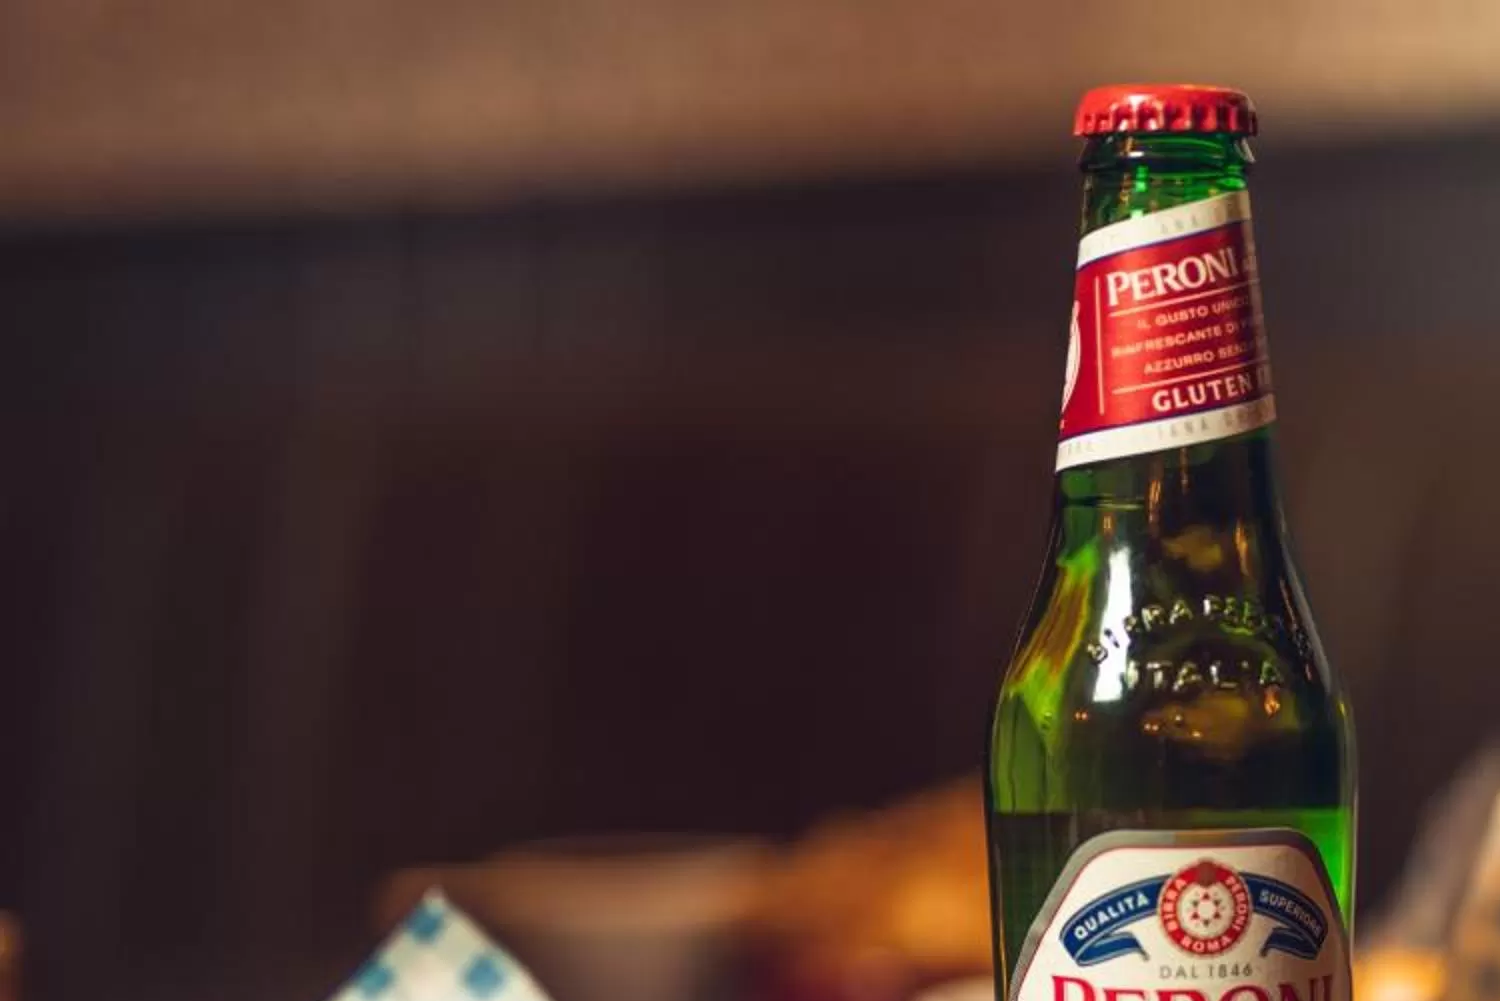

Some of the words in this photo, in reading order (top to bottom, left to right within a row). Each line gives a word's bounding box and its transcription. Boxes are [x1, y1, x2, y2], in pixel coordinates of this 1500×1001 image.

[1106, 247, 1239, 306] PERONI
[1155, 305, 1209, 327] GUSTO
[1143, 350, 1216, 376] AZZURRO
[1152, 371, 1253, 411] GLUTEN
[1073, 891, 1150, 939] QUALITÀ
[1258, 888, 1323, 938] SUPERIORE
[1224, 875, 1248, 931] PERONI
[1180, 935, 1233, 952] ROMA
[1159, 965, 1199, 979] DAL
[1208, 963, 1253, 978] 1846
